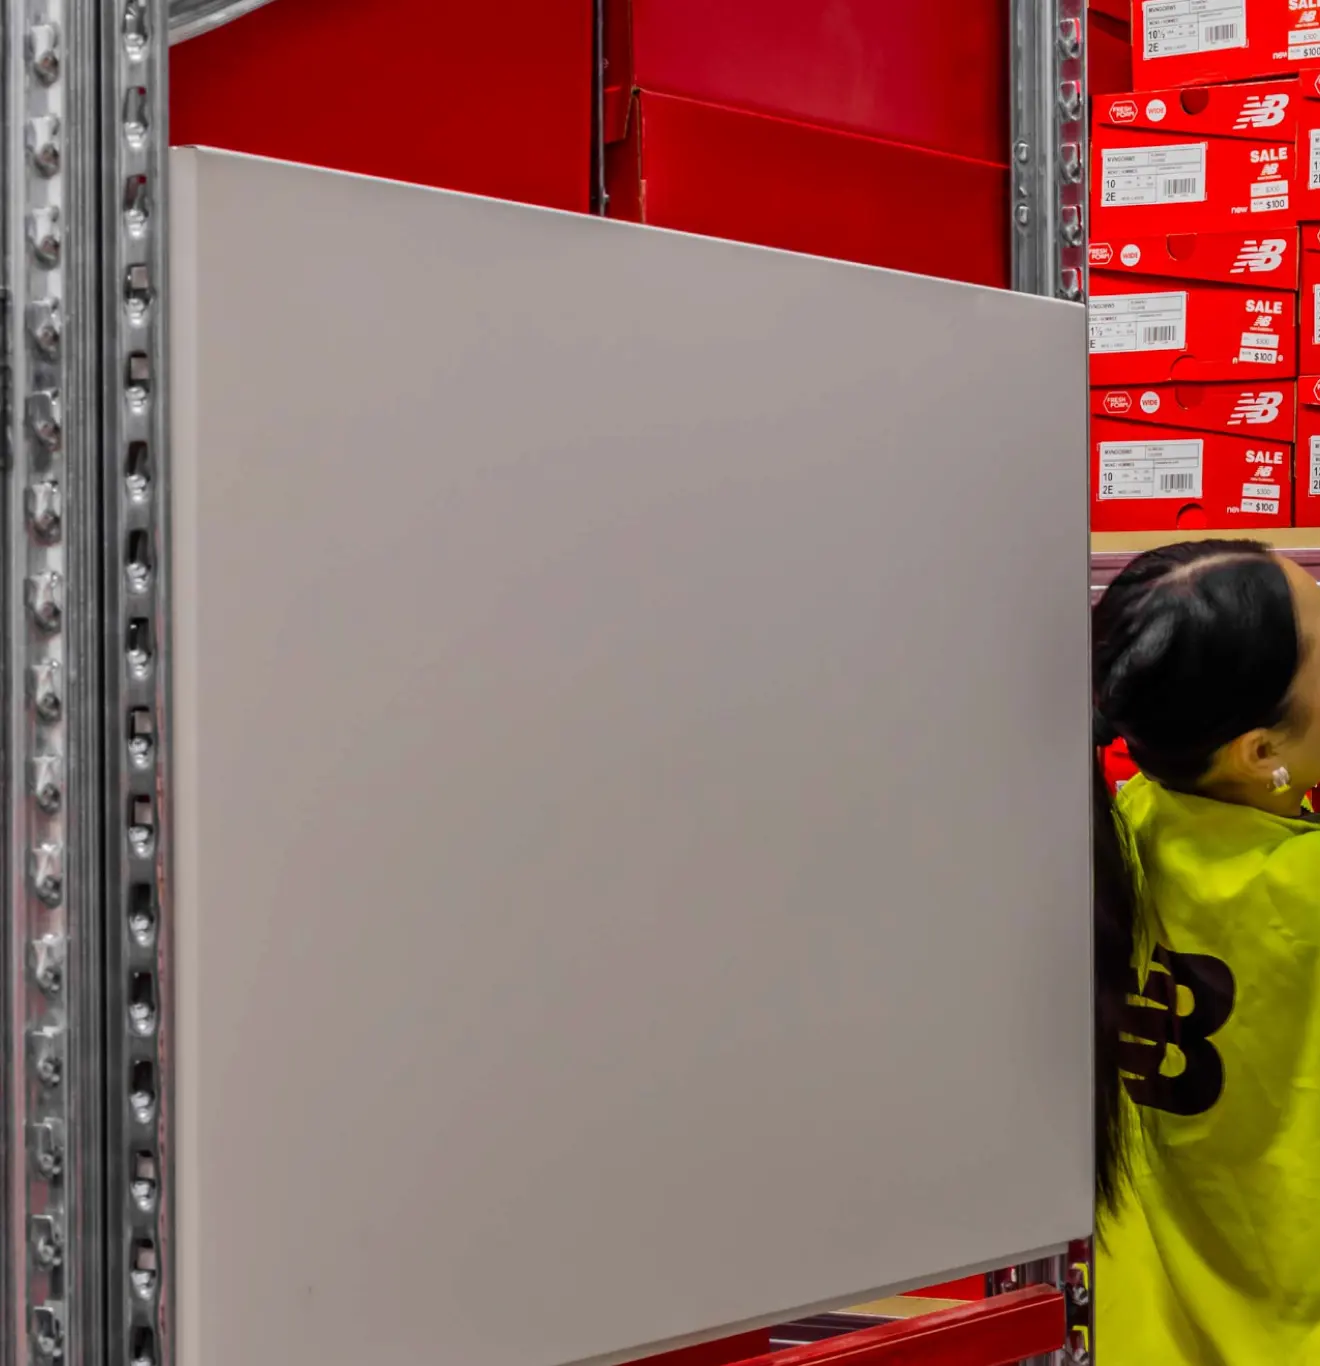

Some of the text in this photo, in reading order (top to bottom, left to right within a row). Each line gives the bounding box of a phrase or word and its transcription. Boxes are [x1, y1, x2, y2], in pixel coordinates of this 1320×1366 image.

[1148, 43, 1158, 52] 2E
[1233, 94, 1289, 130] NB
[1250, 148, 1287, 162] SALE
[1262, 163, 1279, 175] NB
[1106, 180, 1116, 188] 10
[1106, 192, 1116, 202] 2E
[1266, 200, 1285, 209] $100
[1230, 239, 1286, 274] NB
[1246, 300, 1282, 314] SALE
[1253, 316, 1272, 326] NB
[1254, 353, 1272, 361] $100
[1227, 391, 1283, 425] NB
[1246, 451, 1283, 464] SALE
[1104, 472, 1113, 481] 10
[1254, 466, 1272, 477] NB
[1103, 486, 1113, 494] 2E
[1256, 503, 1274, 512] $100
